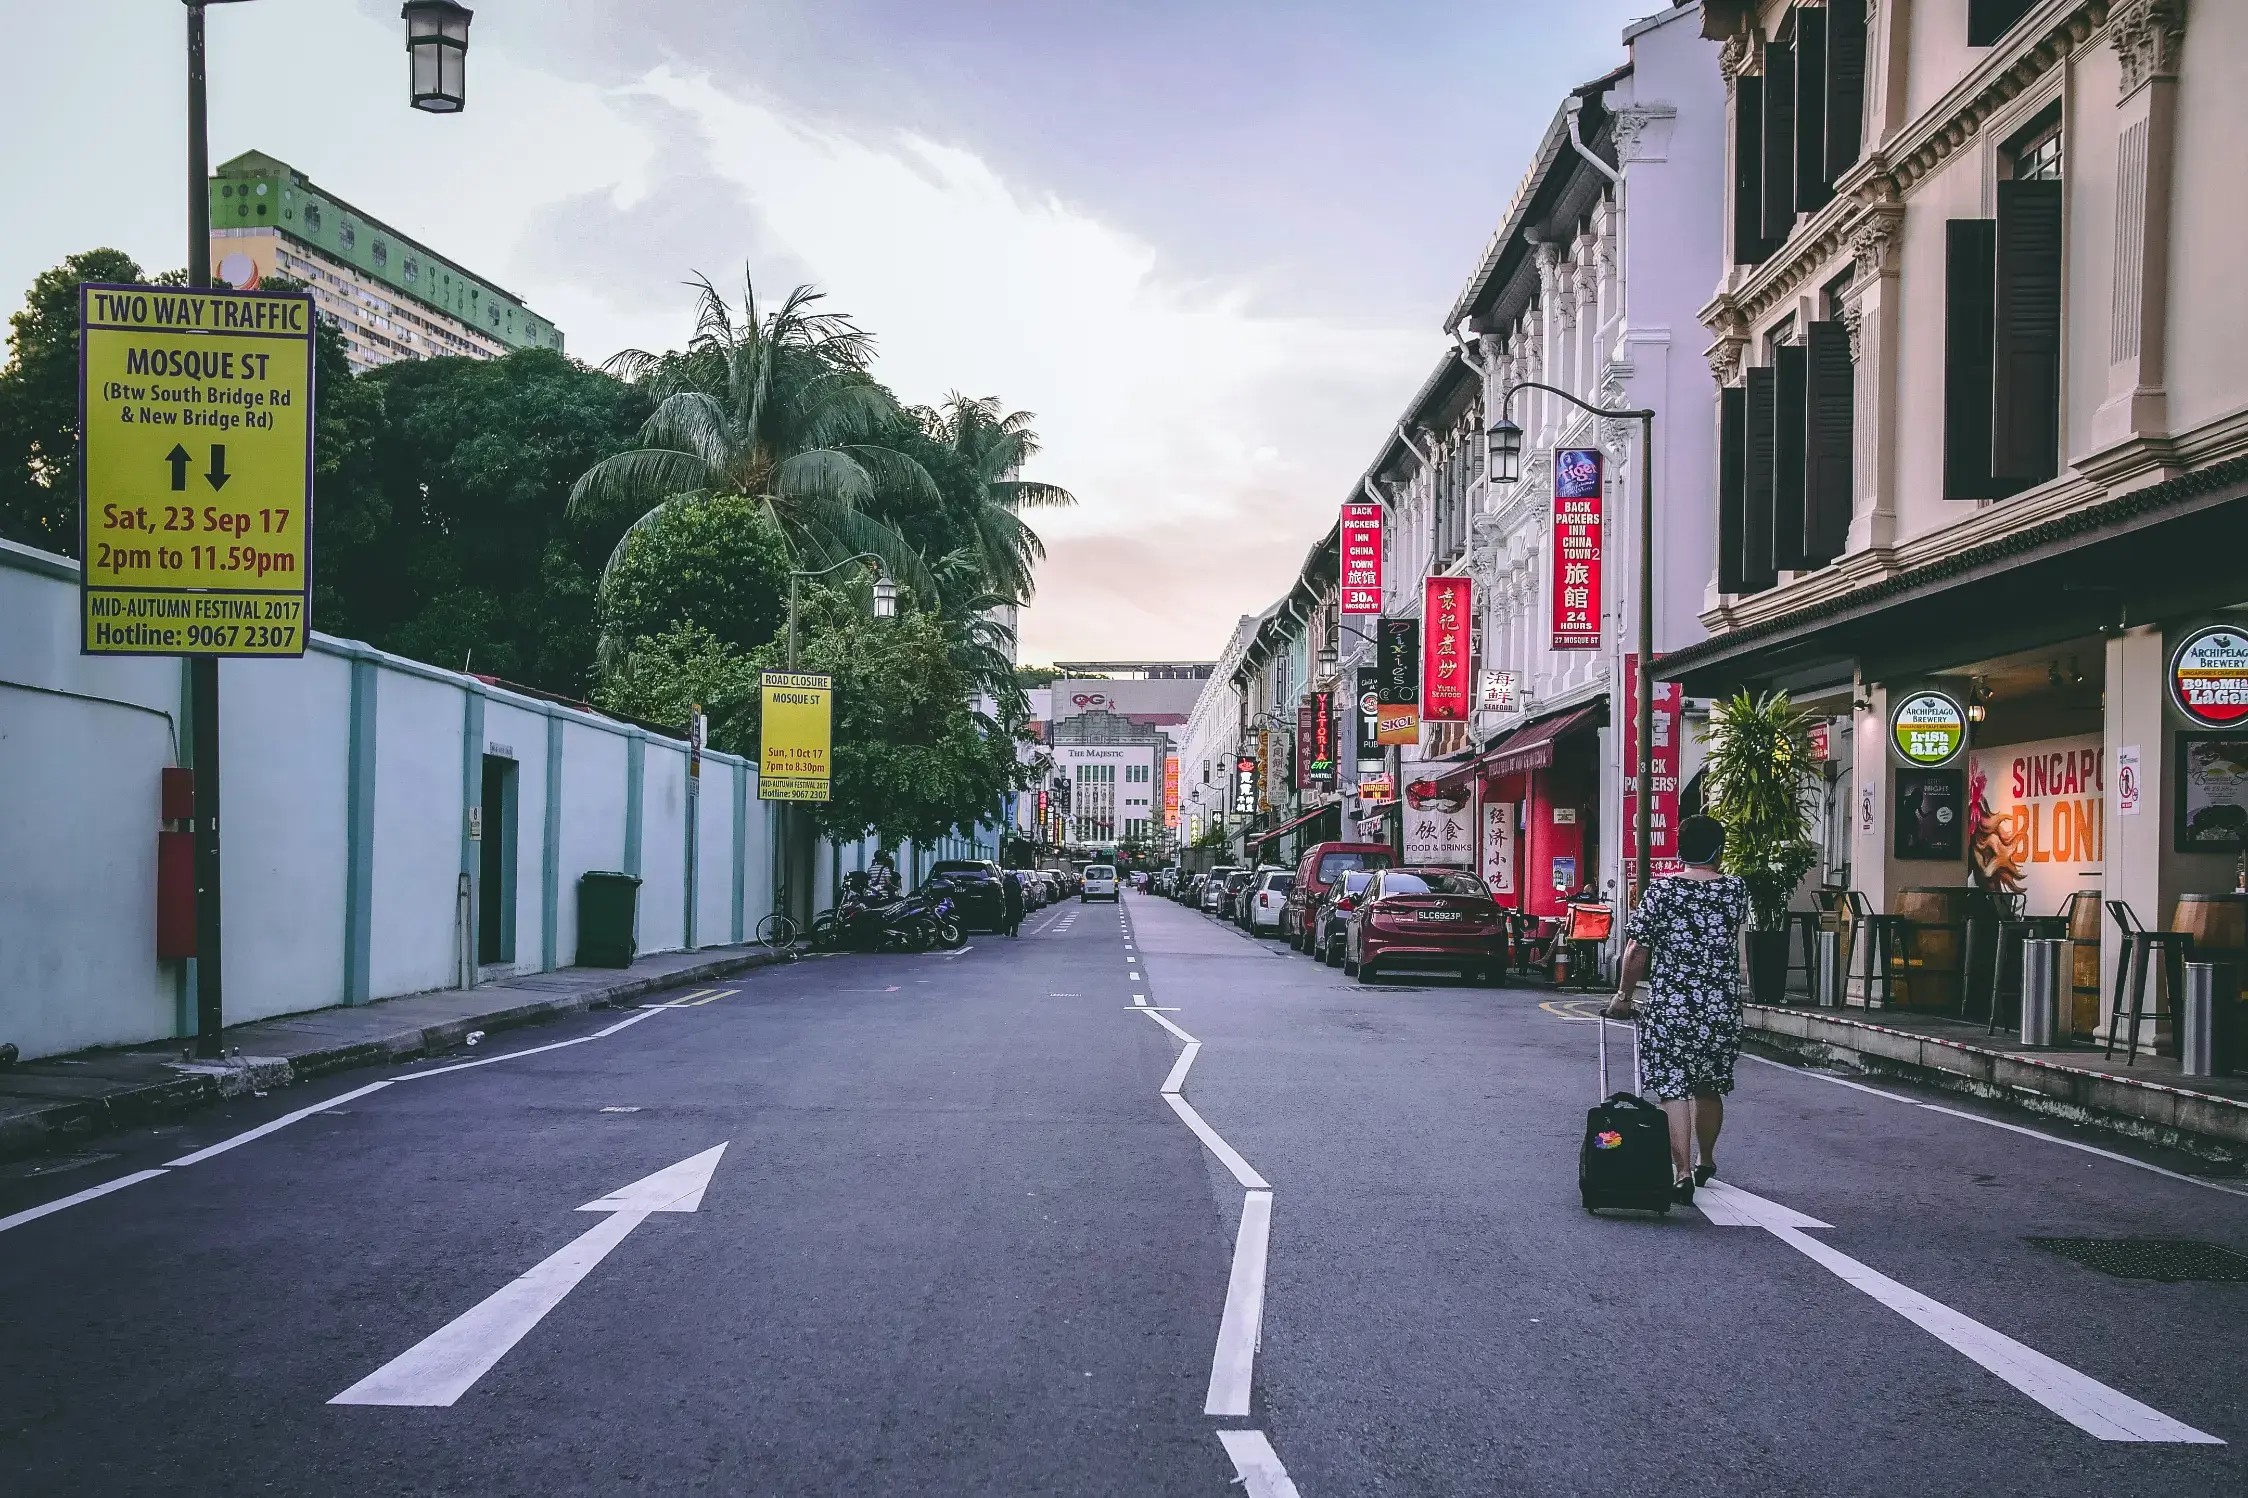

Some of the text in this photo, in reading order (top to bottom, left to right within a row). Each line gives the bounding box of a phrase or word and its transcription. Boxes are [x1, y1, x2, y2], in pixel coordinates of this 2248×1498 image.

[95, 294, 302, 330] TWO WAY TRAFFIC
[126, 348, 269, 381] MOSQUE ST
[103, 382, 291, 409] (Btw South Bridge Rd
[121, 406, 274, 430] & New Bridge Rd)
[1560, 461, 1598, 483] Tiger
[1351, 507, 1373, 515] BACK
[1564, 501, 1591, 513] BACK
[103, 504, 289, 538] Sat, 23 Sep 17
[1344, 520, 1380, 529] PACKERS
[1555, 513, 1600, 525] PACKERS
[1568, 525, 1586, 536] INN
[1354, 533, 1369, 542] INN
[1563, 537, 1592, 548] CHINA
[1349, 546, 1374, 555] CHINA
[97, 543, 295, 577] 2pm to 11.59pm
[1350, 560, 1374, 569] TOWN
[1564, 562, 1589, 609] 旅館
[92, 597, 300, 620] MID-AUTUMN FESTIVAL 2017
[1566, 611, 1586, 622] 24
[1560, 622, 1592, 630] HOURS
[96, 623, 295, 648] Hotline: 9067 2307
[1554, 636, 1563, 644] 27
[2200, 658, 2246, 668] BREWERY
[765, 674, 828, 687] ROAD CLOSURE
[772, 693, 821, 705] MOSQUE ST
[1484, 703, 1513, 711] SEAFOOD
[1906, 707, 1954, 716] ARCHIPELAGO
[1380, 716, 1415, 733] SKOL
[1912, 715, 1948, 723] BREWERY
[1316, 694, 1328, 761] VICTORIA
[768, 747, 823, 758] Sun, 1 Oct 17
[766, 761, 825, 774] 7pm to 8.30pm
[1311, 761, 1332, 770] ENT
[761, 779, 829, 790] MID-AUTUMN FESTIVAL 2017
[762, 788, 827, 799] Hotline: 9067 2307
[1416, 818, 1464, 841] 饮食
[1406, 843, 1473, 852] FOOD & DRINKS
[1488, 807, 1509, 890] 经济小吃
[1418, 911, 1461, 920] SLC6923P
